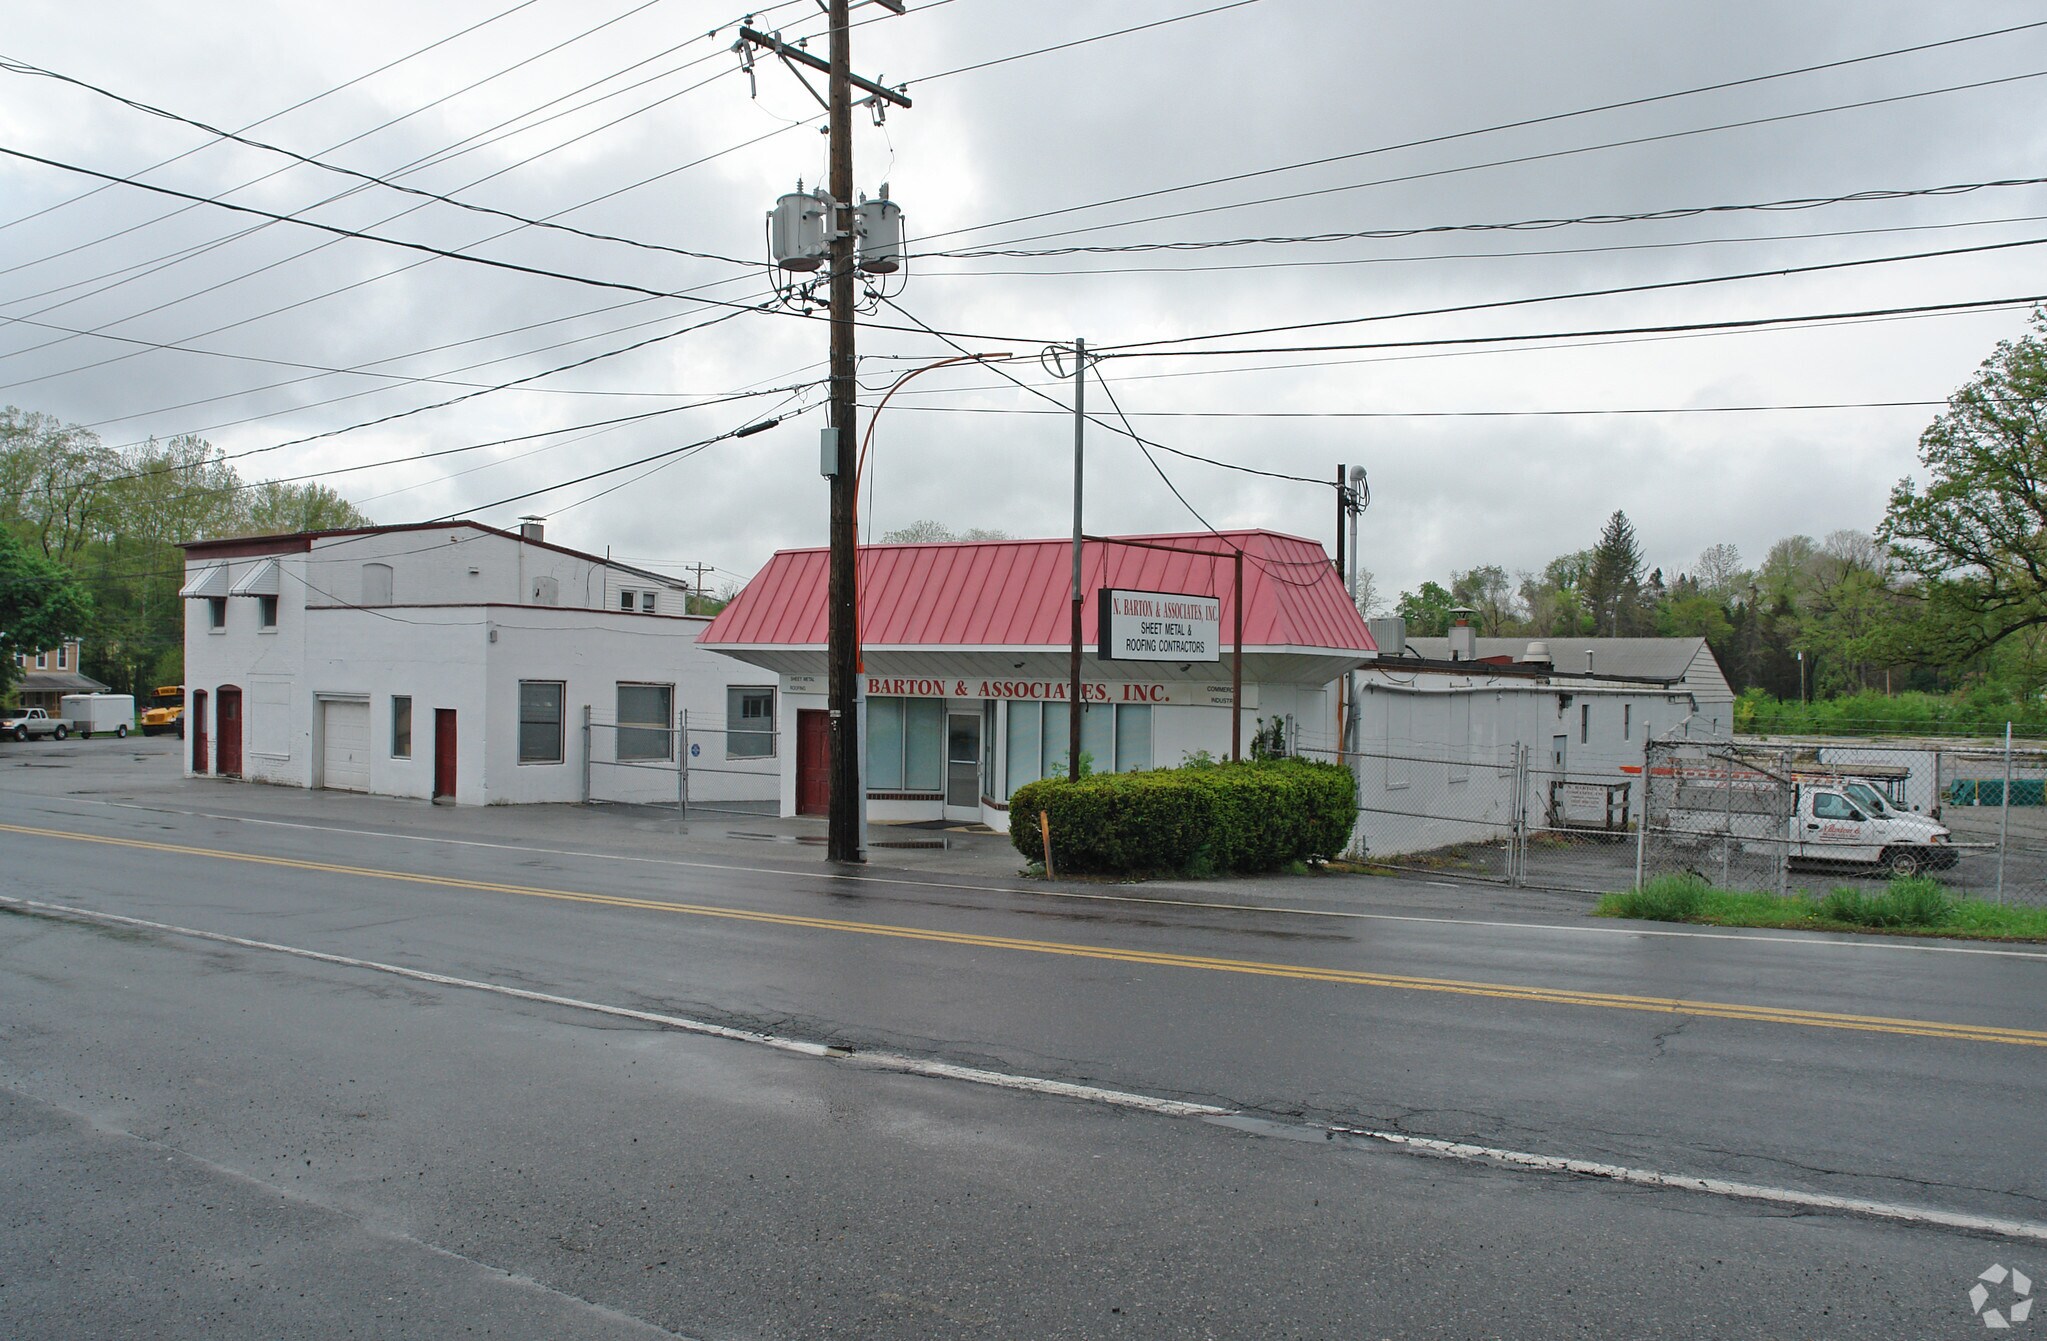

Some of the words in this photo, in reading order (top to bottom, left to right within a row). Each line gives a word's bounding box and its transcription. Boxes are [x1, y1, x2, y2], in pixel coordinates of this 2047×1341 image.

[1113, 598, 1121, 615] N.
[1124, 598, 1153, 618] BARTON
[1155, 601, 1161, 618] &
[1163, 602, 1204, 623] ASSOCIATES,
[1205, 605, 1219, 622] INC.
[1140, 621, 1162, 635] SHEET
[1165, 623, 1185, 636] METAL
[1187, 624, 1192, 636] &
[1126, 638, 1157, 652] ROOFING
[1158, 640, 1205, 654] CONTRACTORS
[868, 678, 946, 696] BARTON
[954, 680, 968, 696] &
[1122, 684, 1170, 702] INC.
